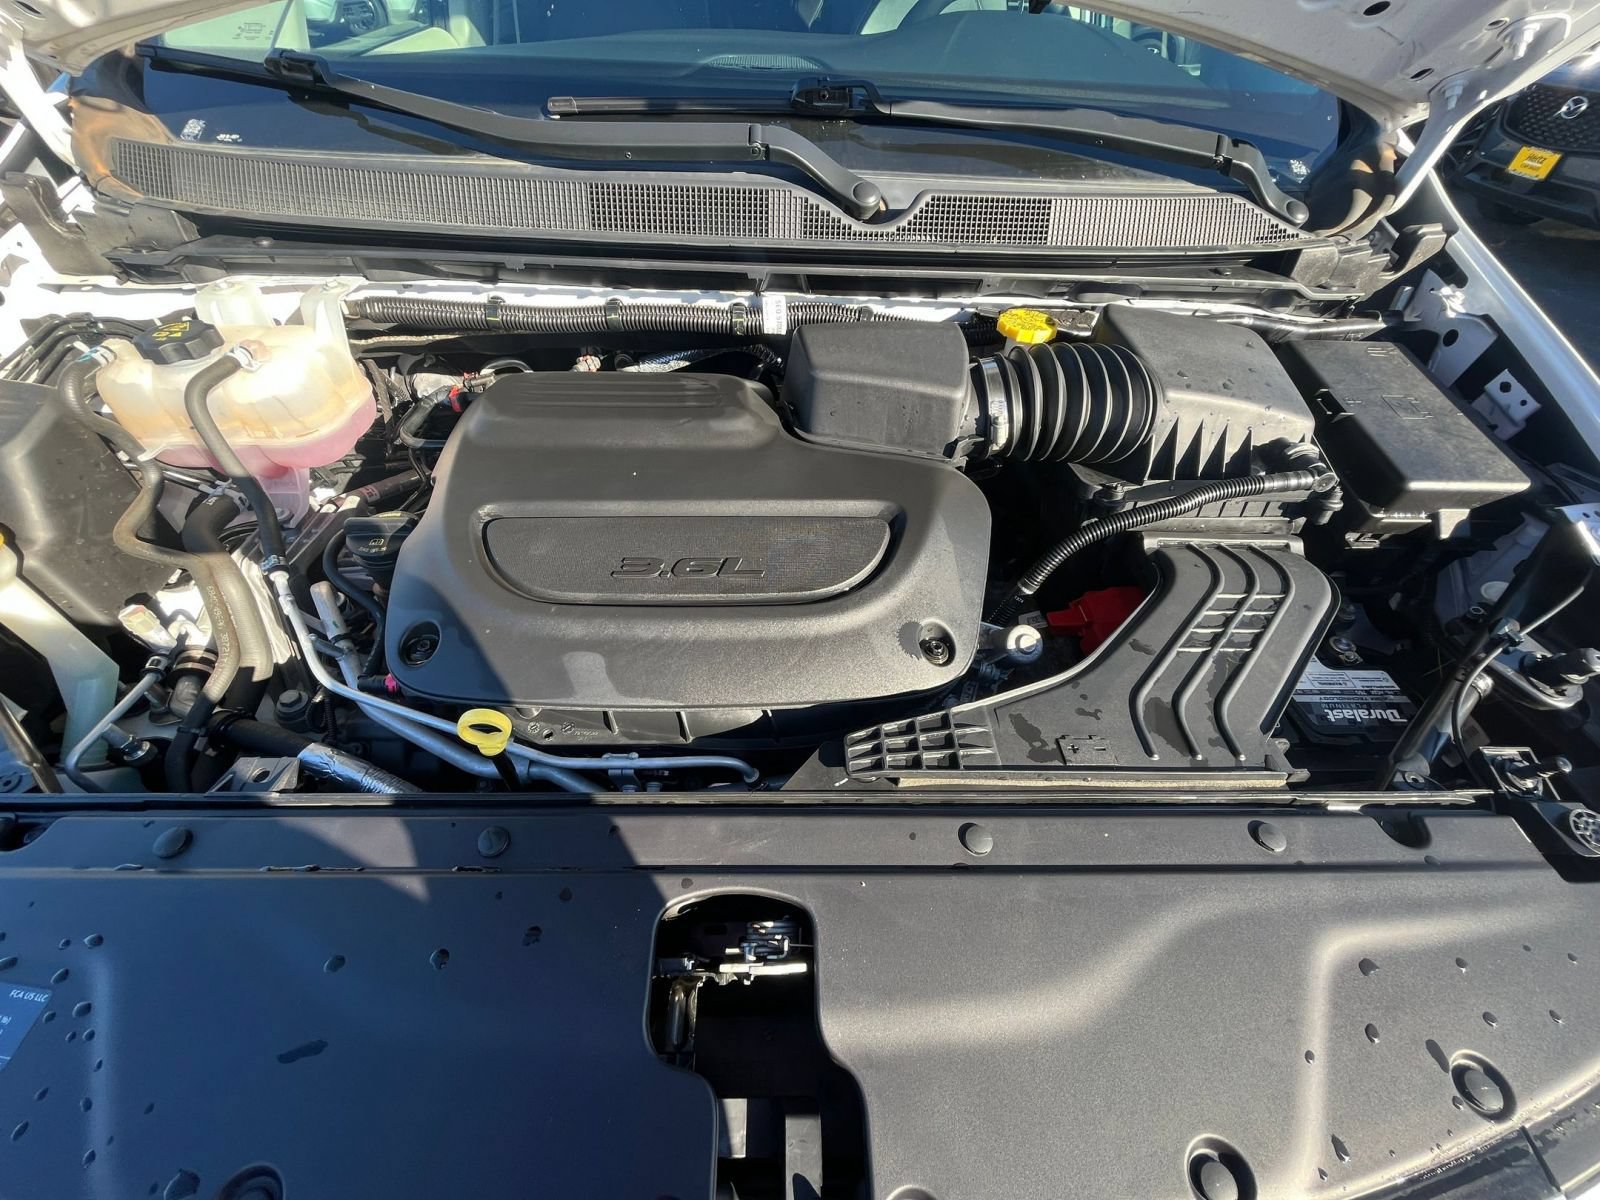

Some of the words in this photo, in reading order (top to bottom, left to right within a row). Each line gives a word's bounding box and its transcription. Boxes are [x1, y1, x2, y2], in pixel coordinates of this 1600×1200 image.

[610, 557, 766, 578] 3.6L
[1324, 709, 1408, 722] Duralast
[9, 989, 24, 999] FCA
[24, 991, 36, 1001] US
[34, 993, 49, 1003] LLC
